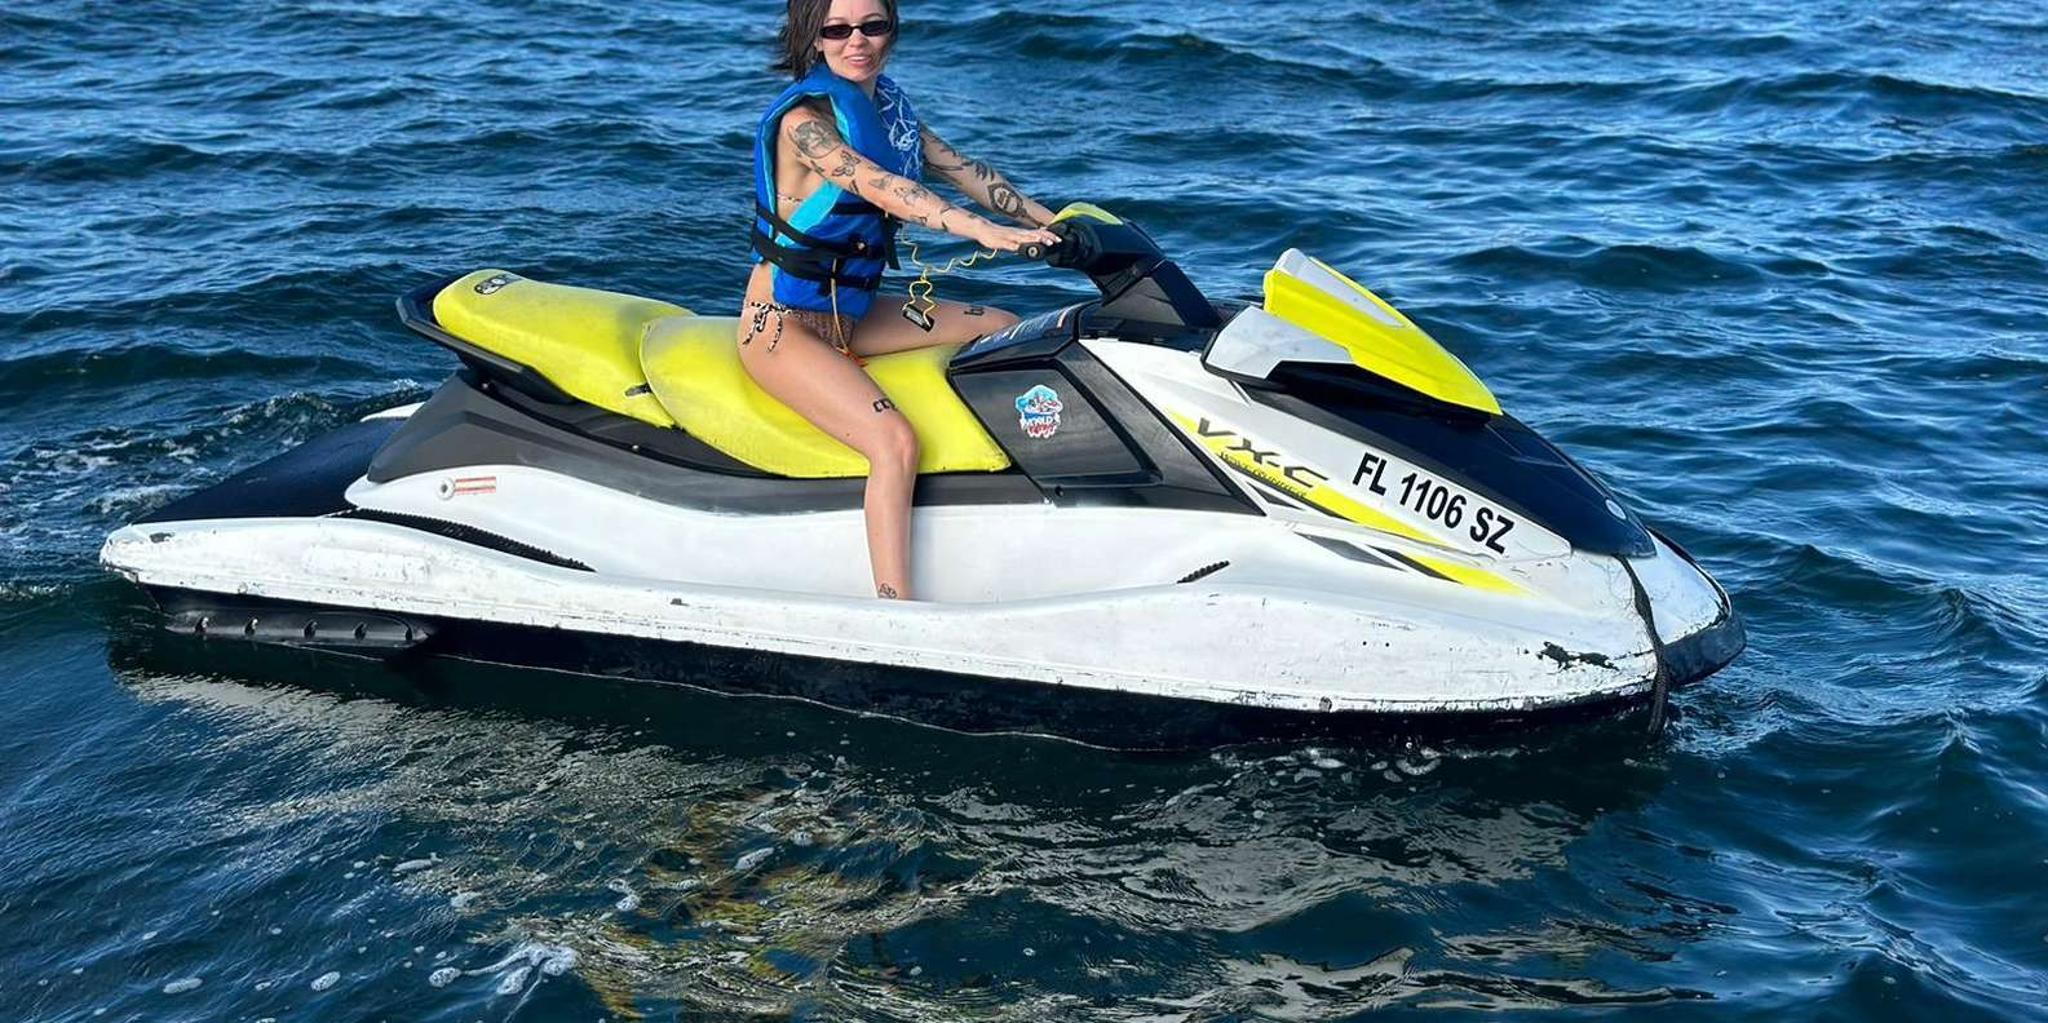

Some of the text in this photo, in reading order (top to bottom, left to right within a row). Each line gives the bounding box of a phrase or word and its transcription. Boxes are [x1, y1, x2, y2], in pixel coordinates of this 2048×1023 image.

[1353, 452, 1514, 554] FL 1106 SZ
